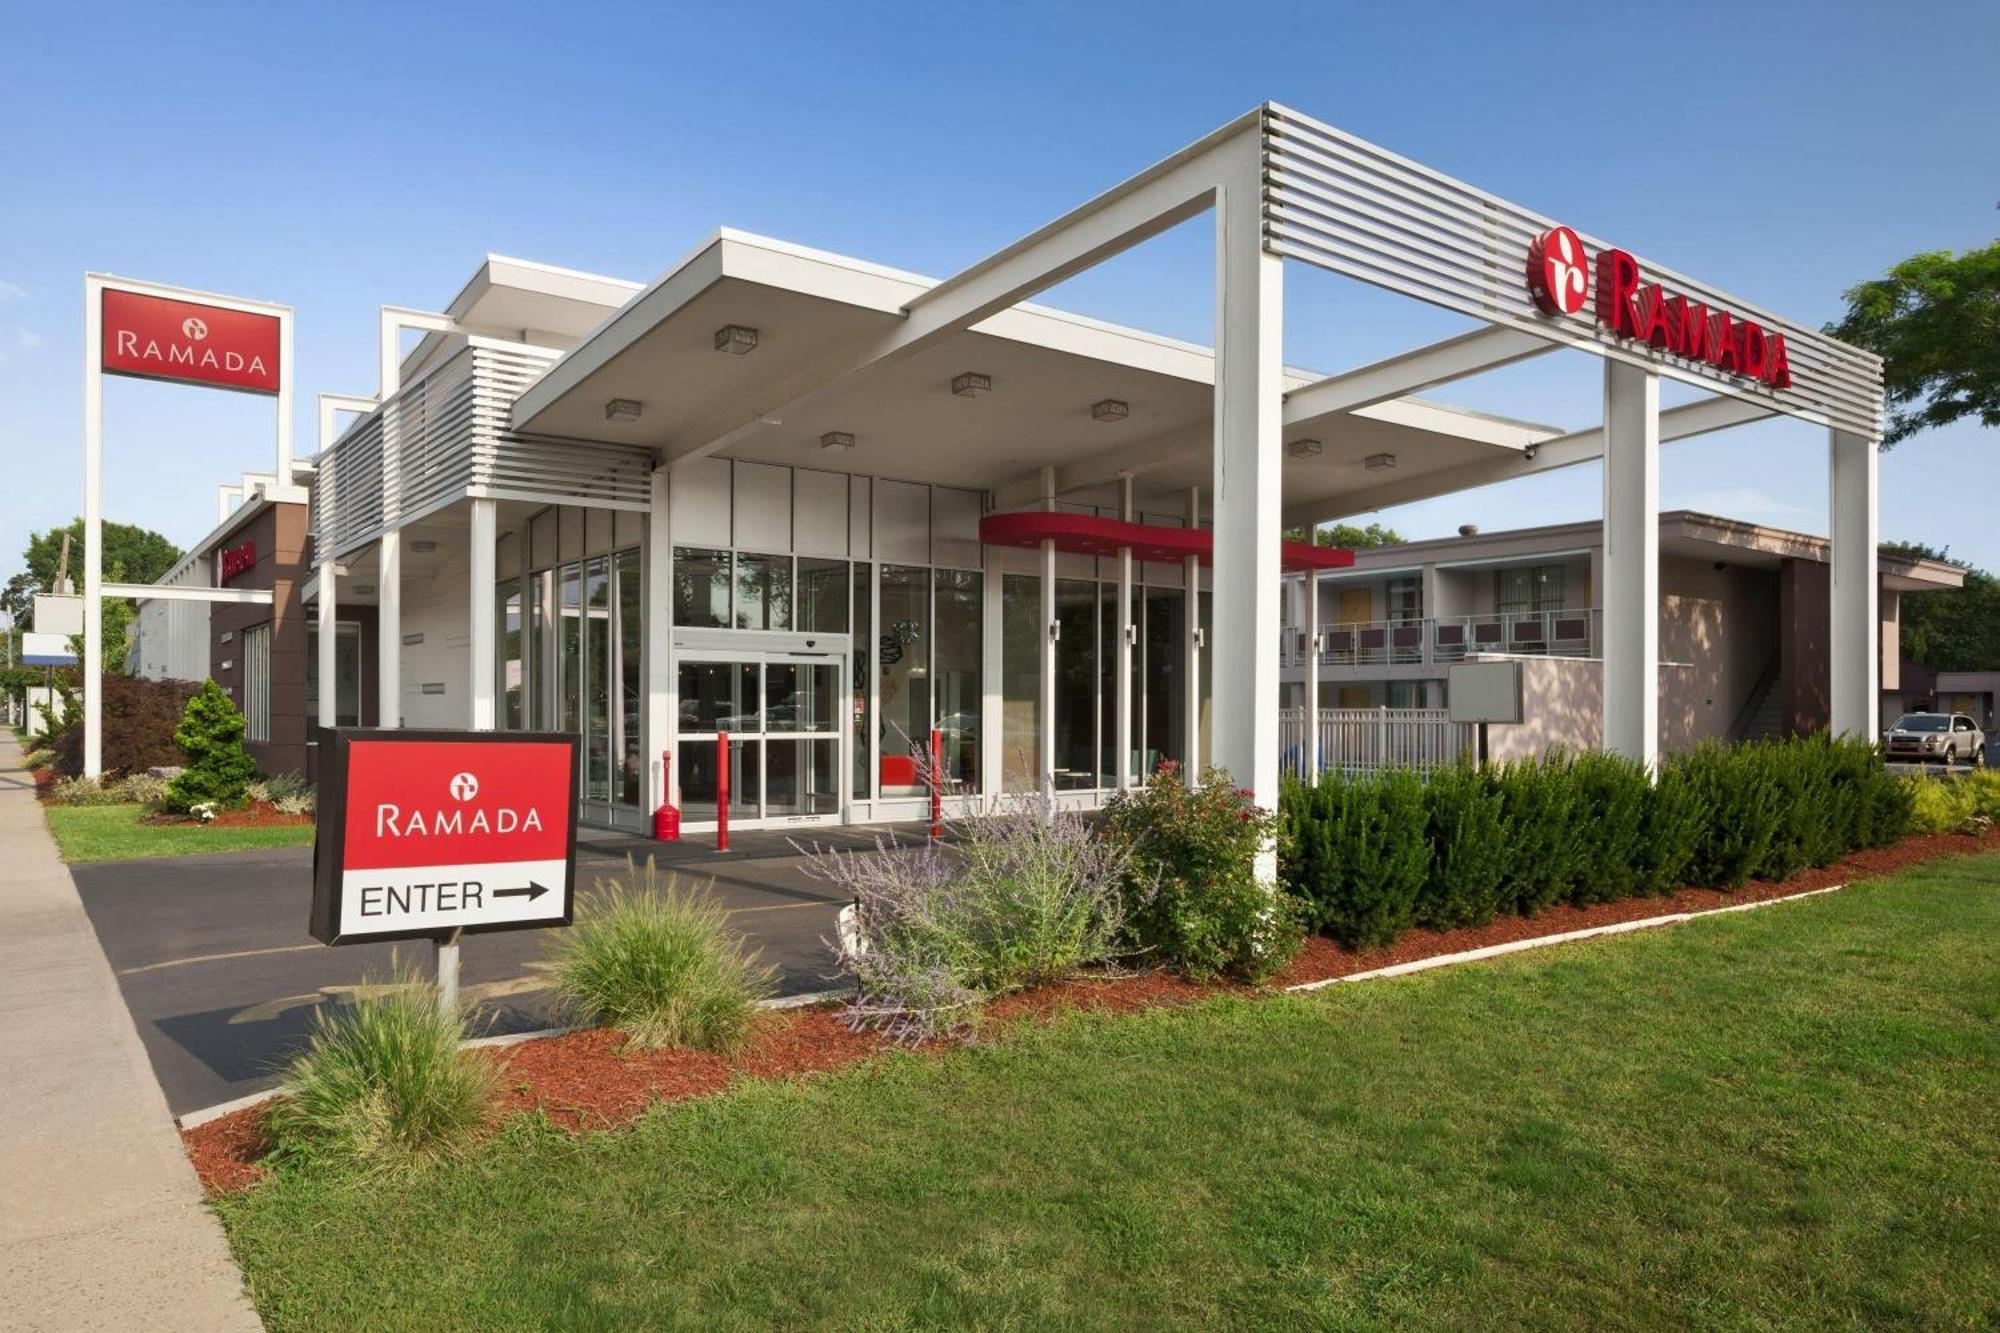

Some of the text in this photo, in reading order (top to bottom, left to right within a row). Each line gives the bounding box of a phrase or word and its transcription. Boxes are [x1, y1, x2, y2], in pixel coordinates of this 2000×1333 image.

[1596, 248, 1792, 389] RAMADA
[117, 330, 267, 376] RAMADA
[376, 804, 543, 837] RAMADA
[360, 881, 483, 917] ENTER
